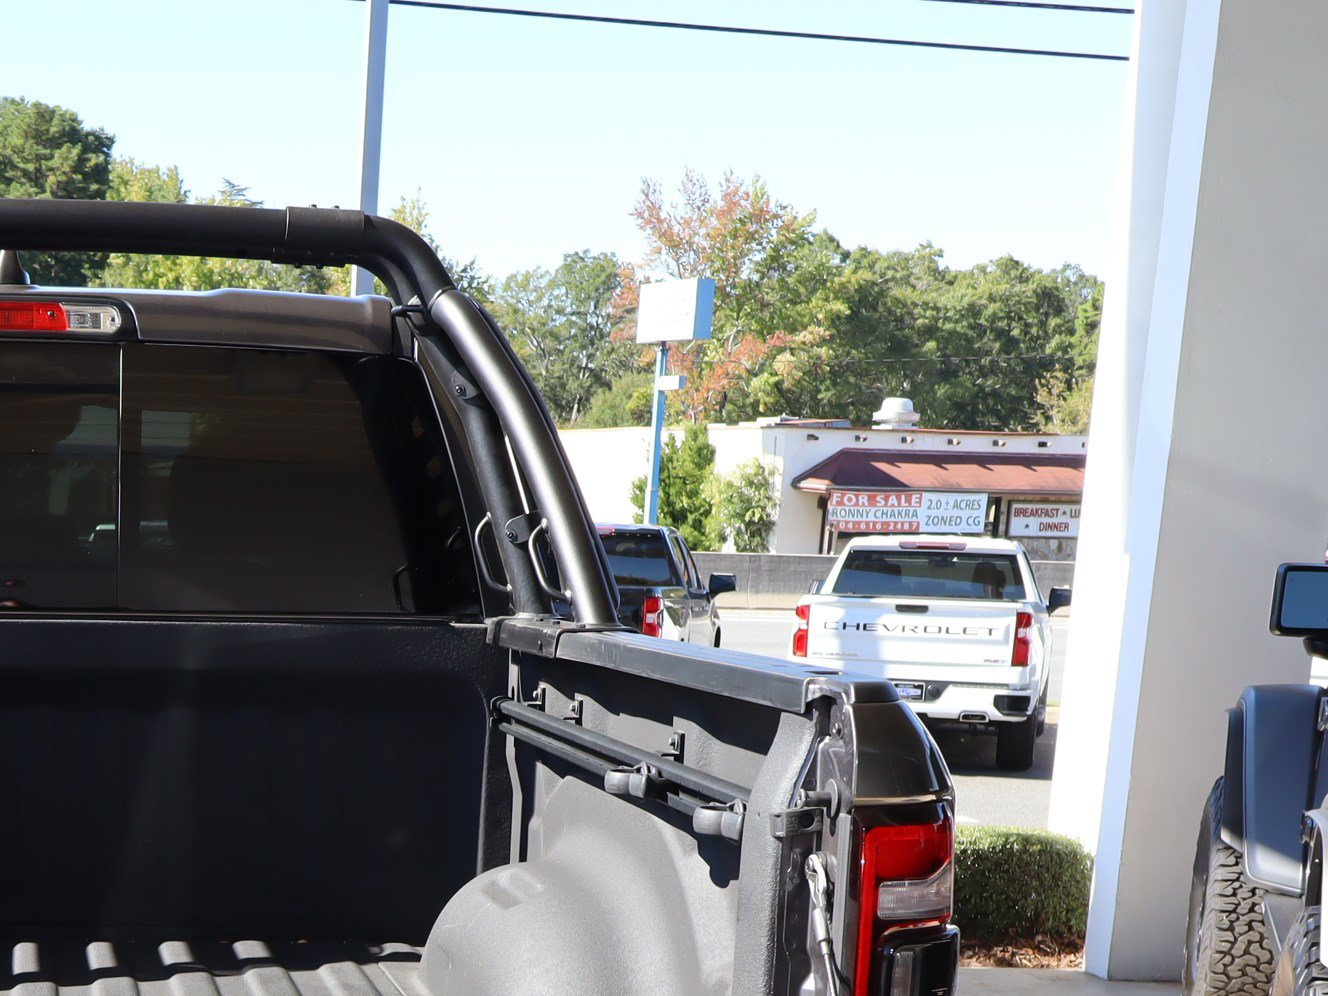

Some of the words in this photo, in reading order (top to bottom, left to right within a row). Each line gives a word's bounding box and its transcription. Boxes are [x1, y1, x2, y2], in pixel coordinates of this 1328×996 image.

[831, 493, 868, 506] FOR
[875, 494, 921, 507] SALE
[926, 499, 942, 511] 2.0
[952, 499, 982, 511] ACRES
[831, 508, 871, 519] RONNY
[873, 508, 919, 520] CHAKRA
[1013, 507, 1060, 518] BREAKFAST
[925, 515, 963, 527] ZONED
[965, 515, 981, 527] CG
[1038, 521, 1070, 532] DINNER
[823, 621, 999, 637] CHEVROLET
